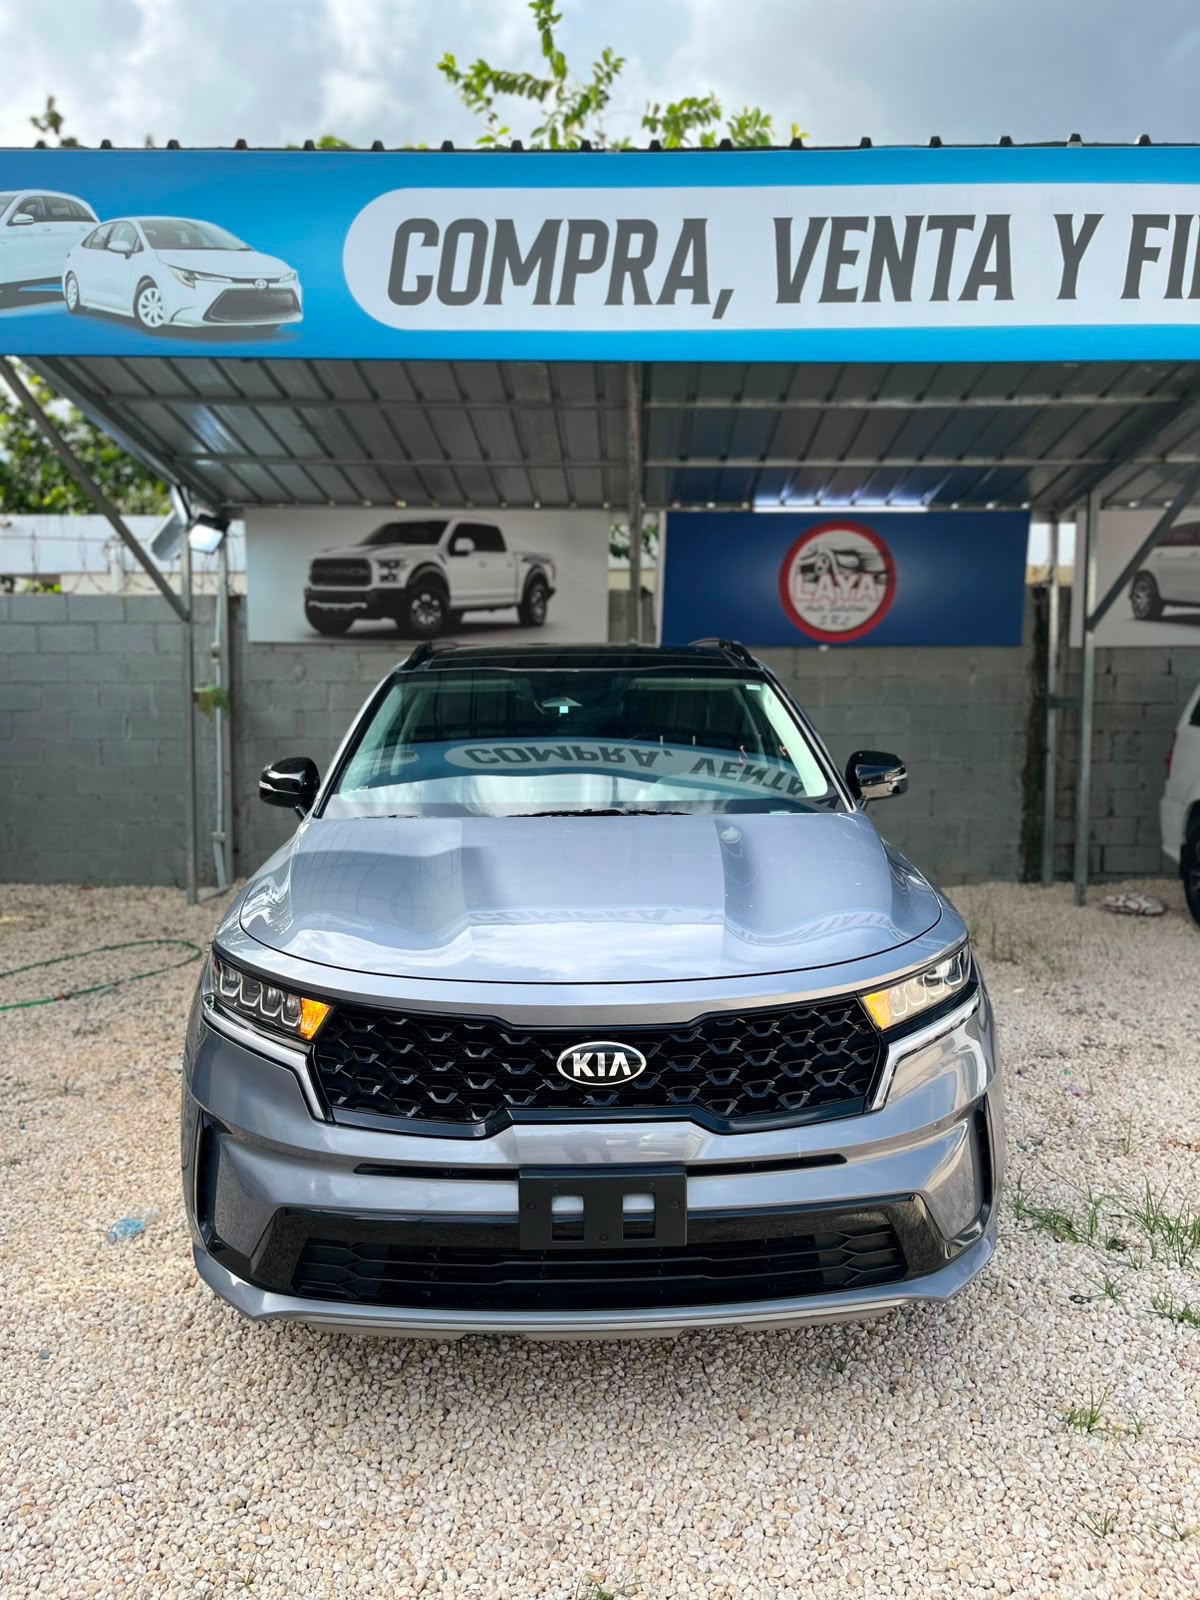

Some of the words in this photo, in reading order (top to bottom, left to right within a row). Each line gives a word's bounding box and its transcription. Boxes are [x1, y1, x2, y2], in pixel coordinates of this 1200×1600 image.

[387, 218, 734, 320] COMPRA,
[773, 214, 1014, 304] VENTA
[1053, 213, 1105, 300] Y
[1120, 213, 1200, 300] FI
[794, 572, 880, 601] LAYA
[572, 1051, 632, 1077] KIA
